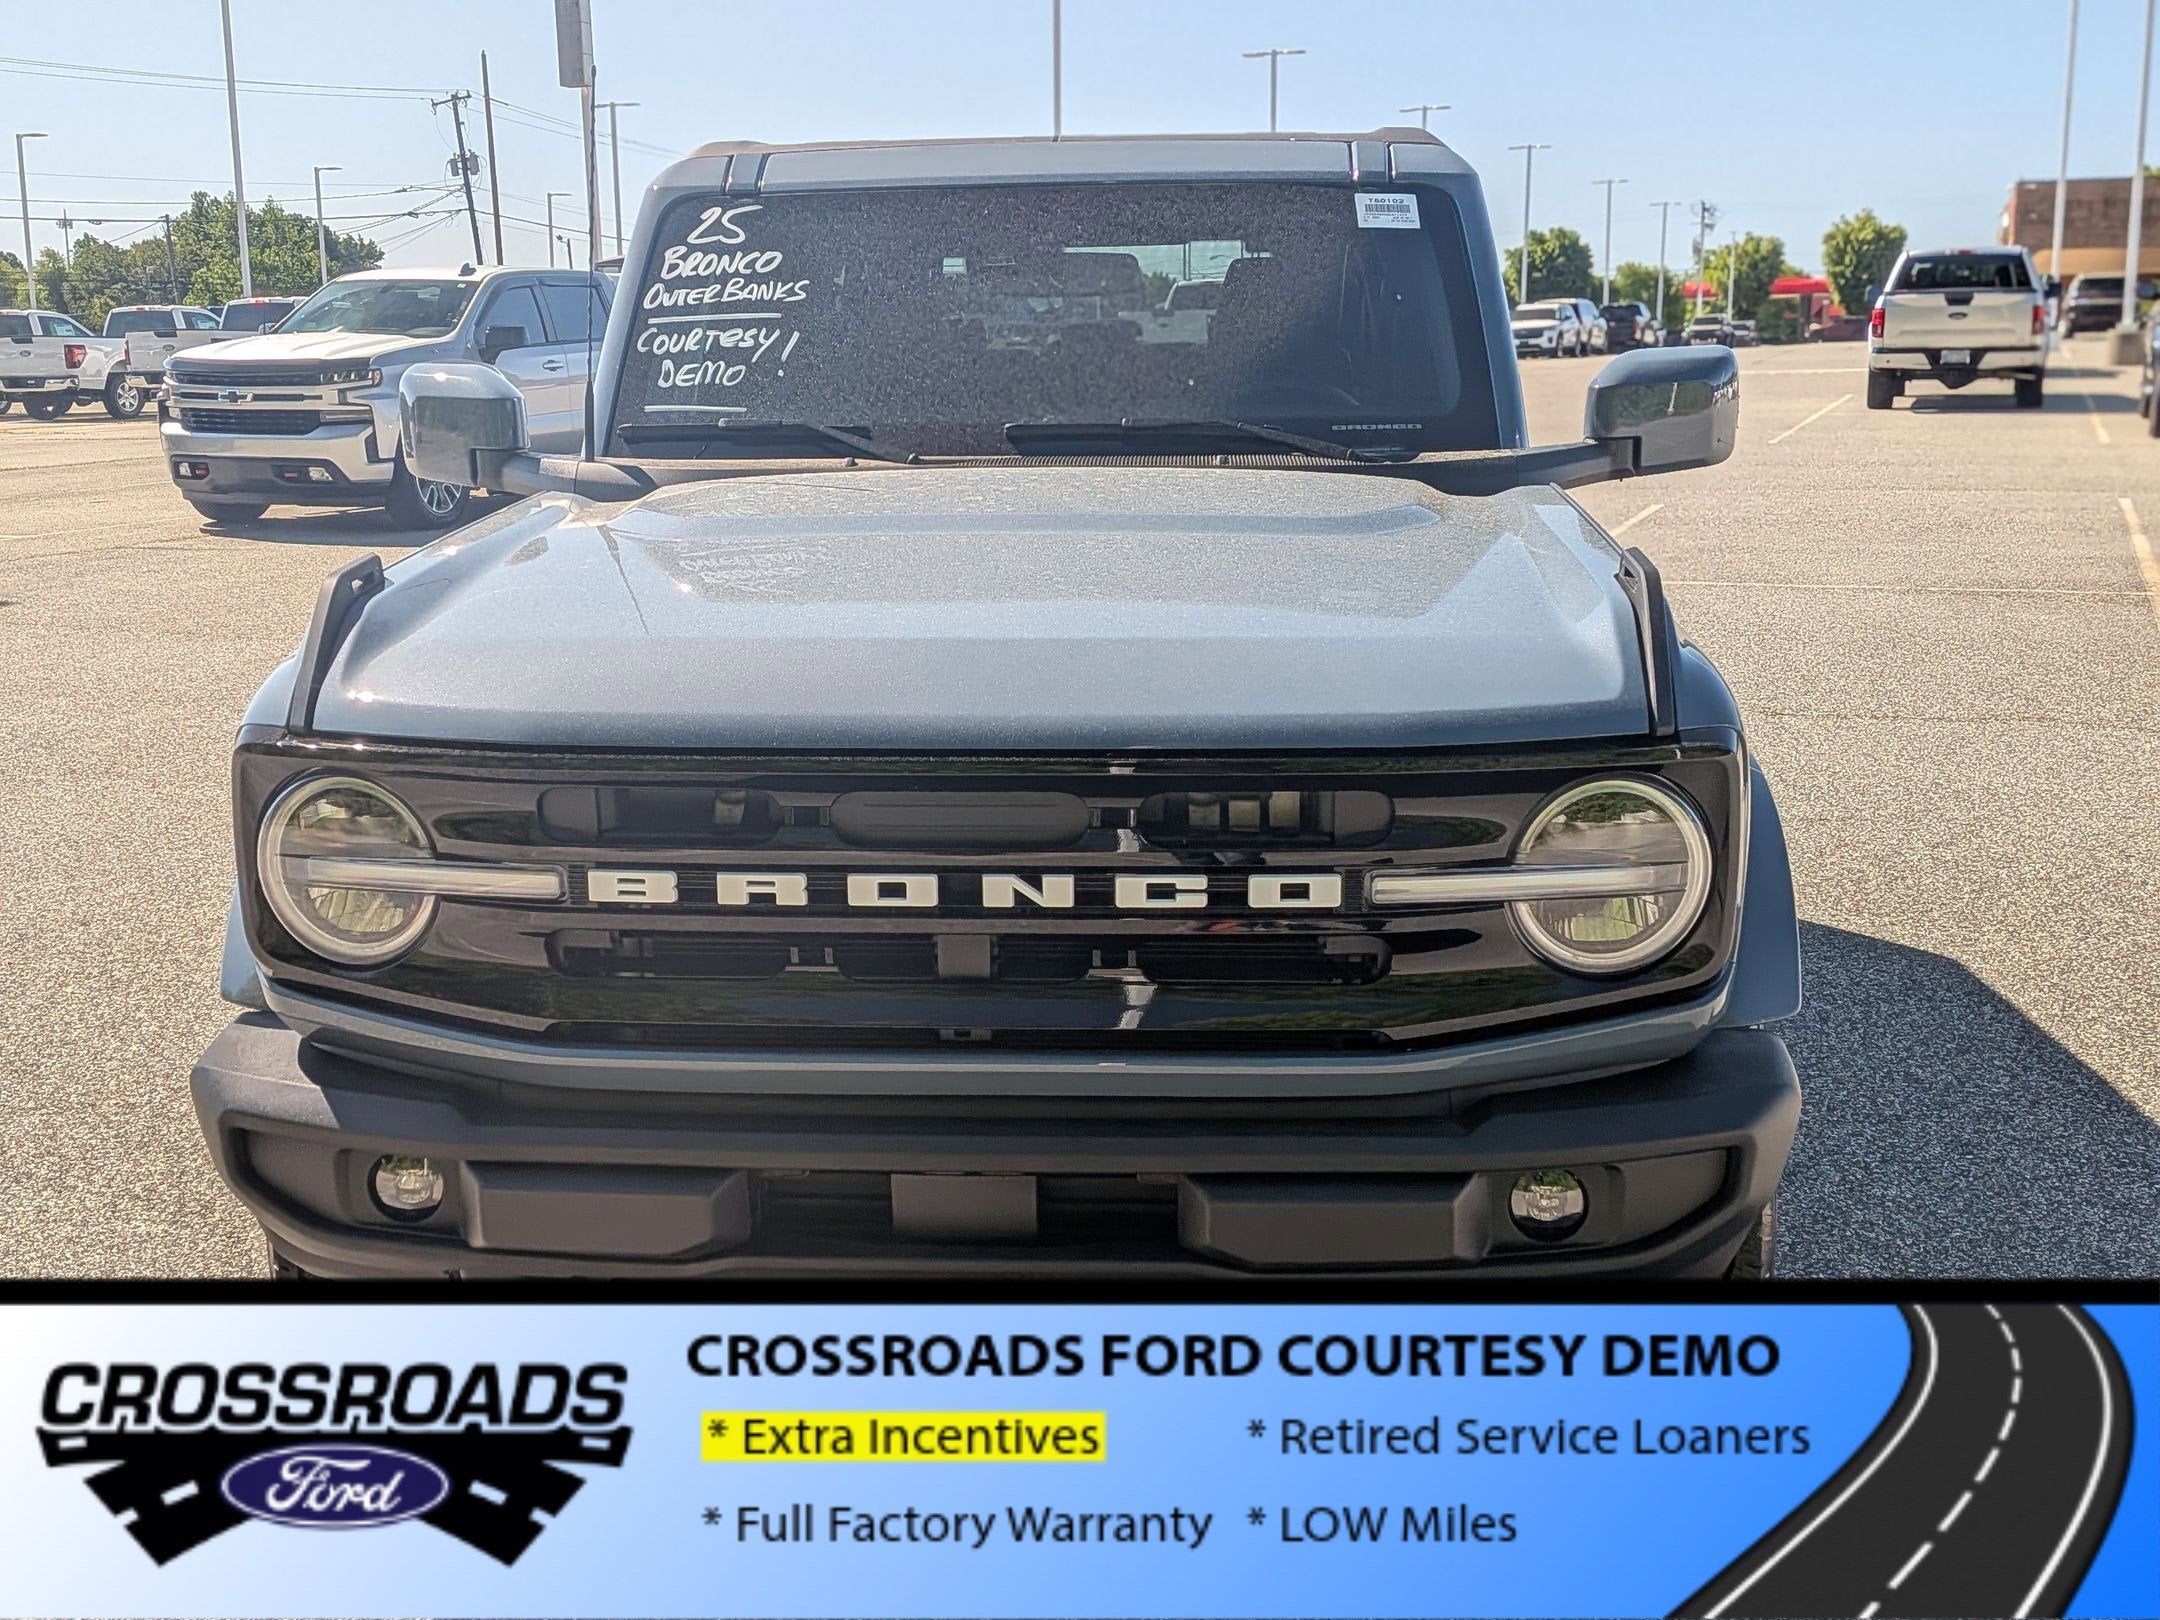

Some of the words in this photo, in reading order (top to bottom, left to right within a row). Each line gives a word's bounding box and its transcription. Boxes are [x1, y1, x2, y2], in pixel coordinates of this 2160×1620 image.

[687, 205, 763, 244] 25
[660, 246, 783, 279] BRONCO
[657, 359, 746, 388] DEMO
[587, 870, 1342, 908] BRONCO
